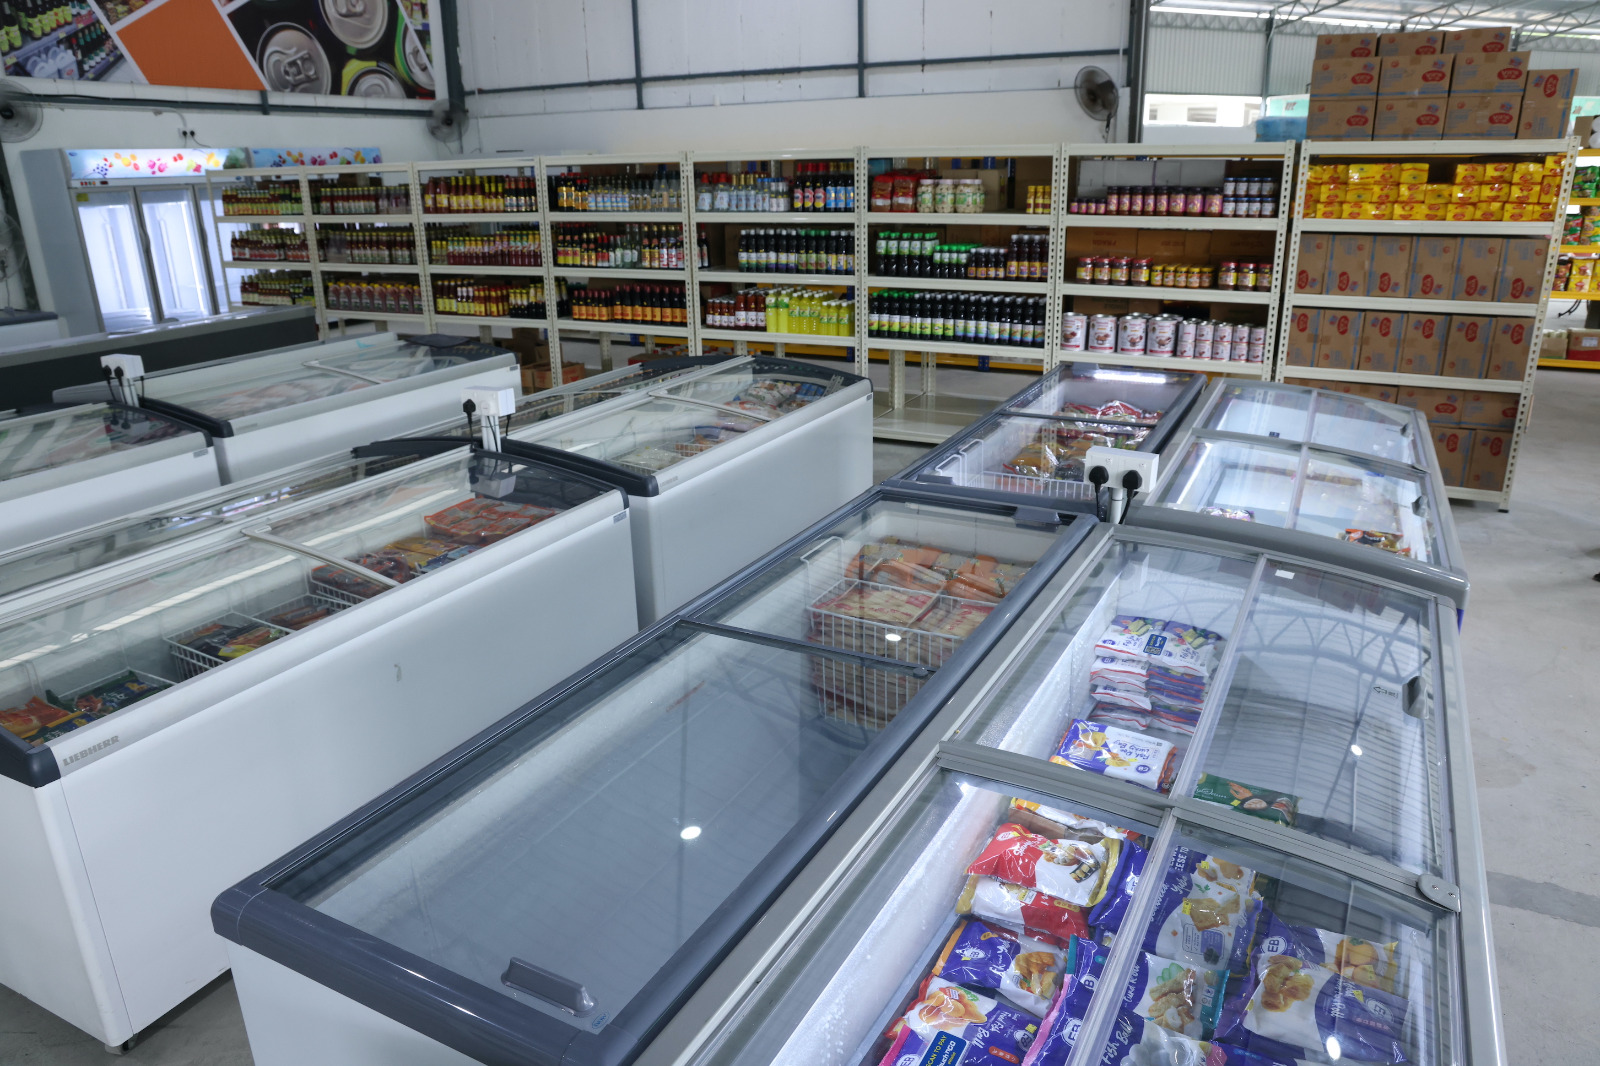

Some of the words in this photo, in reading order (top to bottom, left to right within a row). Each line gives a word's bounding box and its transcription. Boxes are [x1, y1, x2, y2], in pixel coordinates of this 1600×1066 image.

[63, 736, 119, 766] LIEBHERR
[1268, 939, 1280, 953] EB
[934, 1045, 942, 1054] TO
[940, 1034, 948, 1047] PAY
[971, 1027, 991, 1050] Ball
